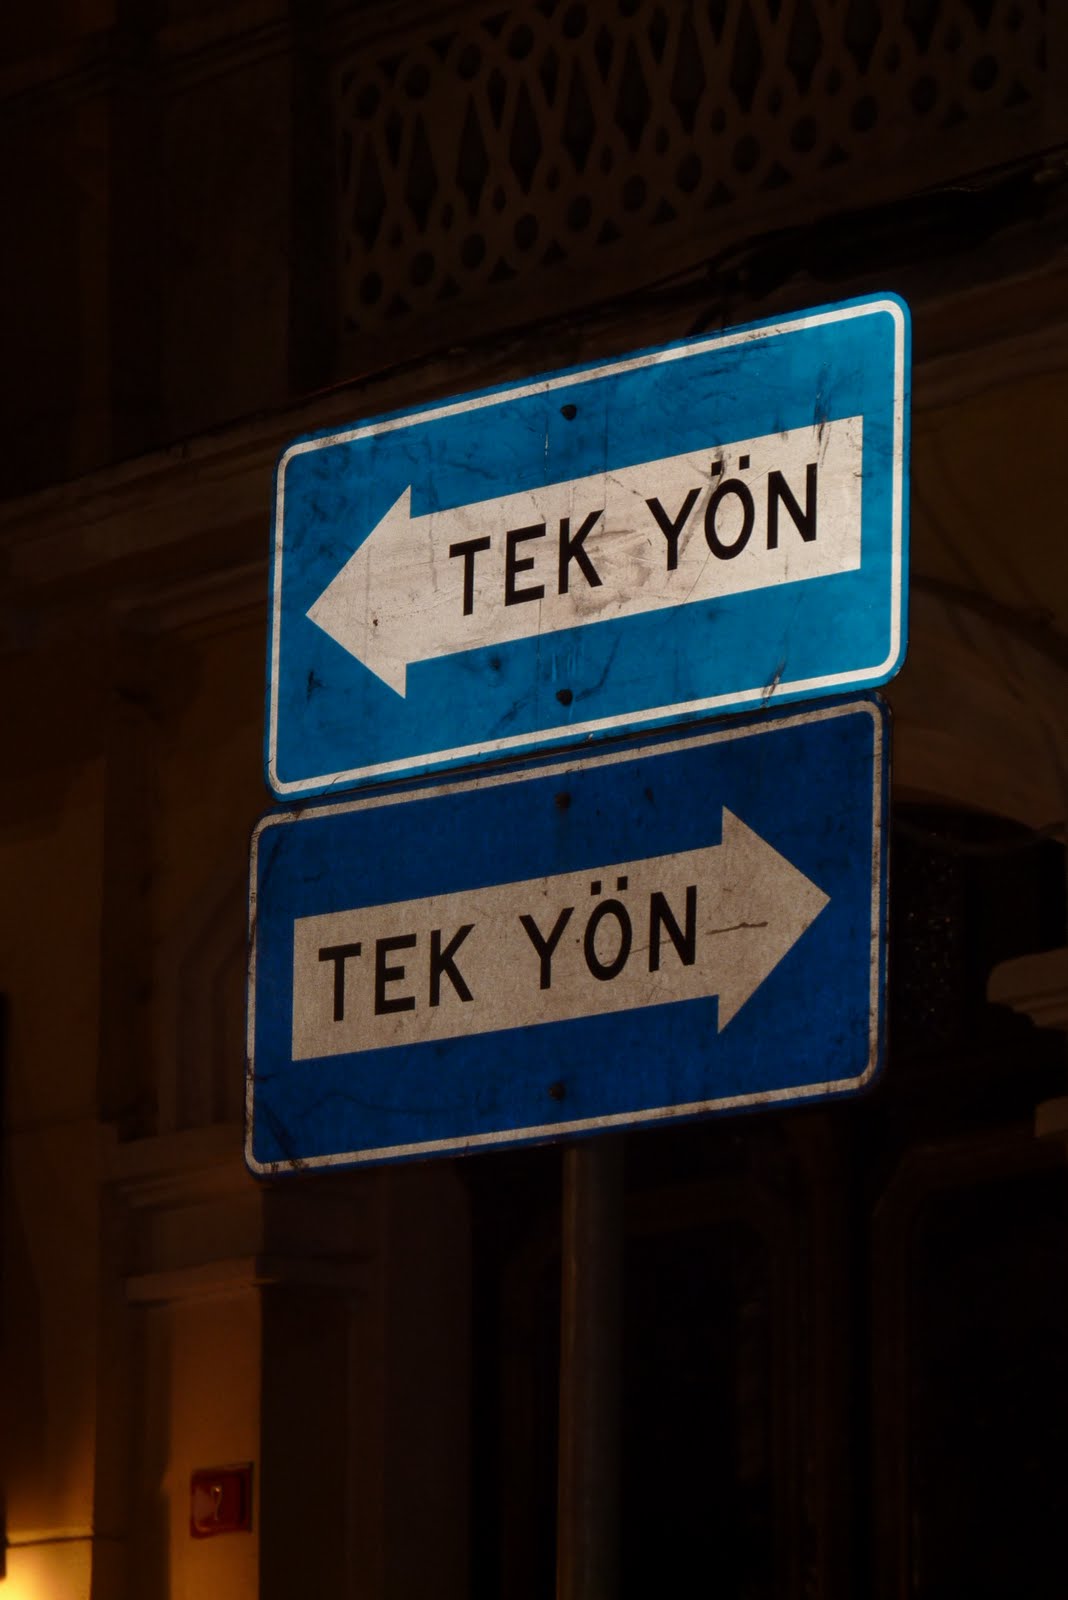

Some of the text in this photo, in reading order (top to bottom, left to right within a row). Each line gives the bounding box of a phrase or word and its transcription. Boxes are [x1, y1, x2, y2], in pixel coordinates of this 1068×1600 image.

[449, 456, 817, 616] TEK YÖN
[319, 877, 696, 1021] TEK YÖN
